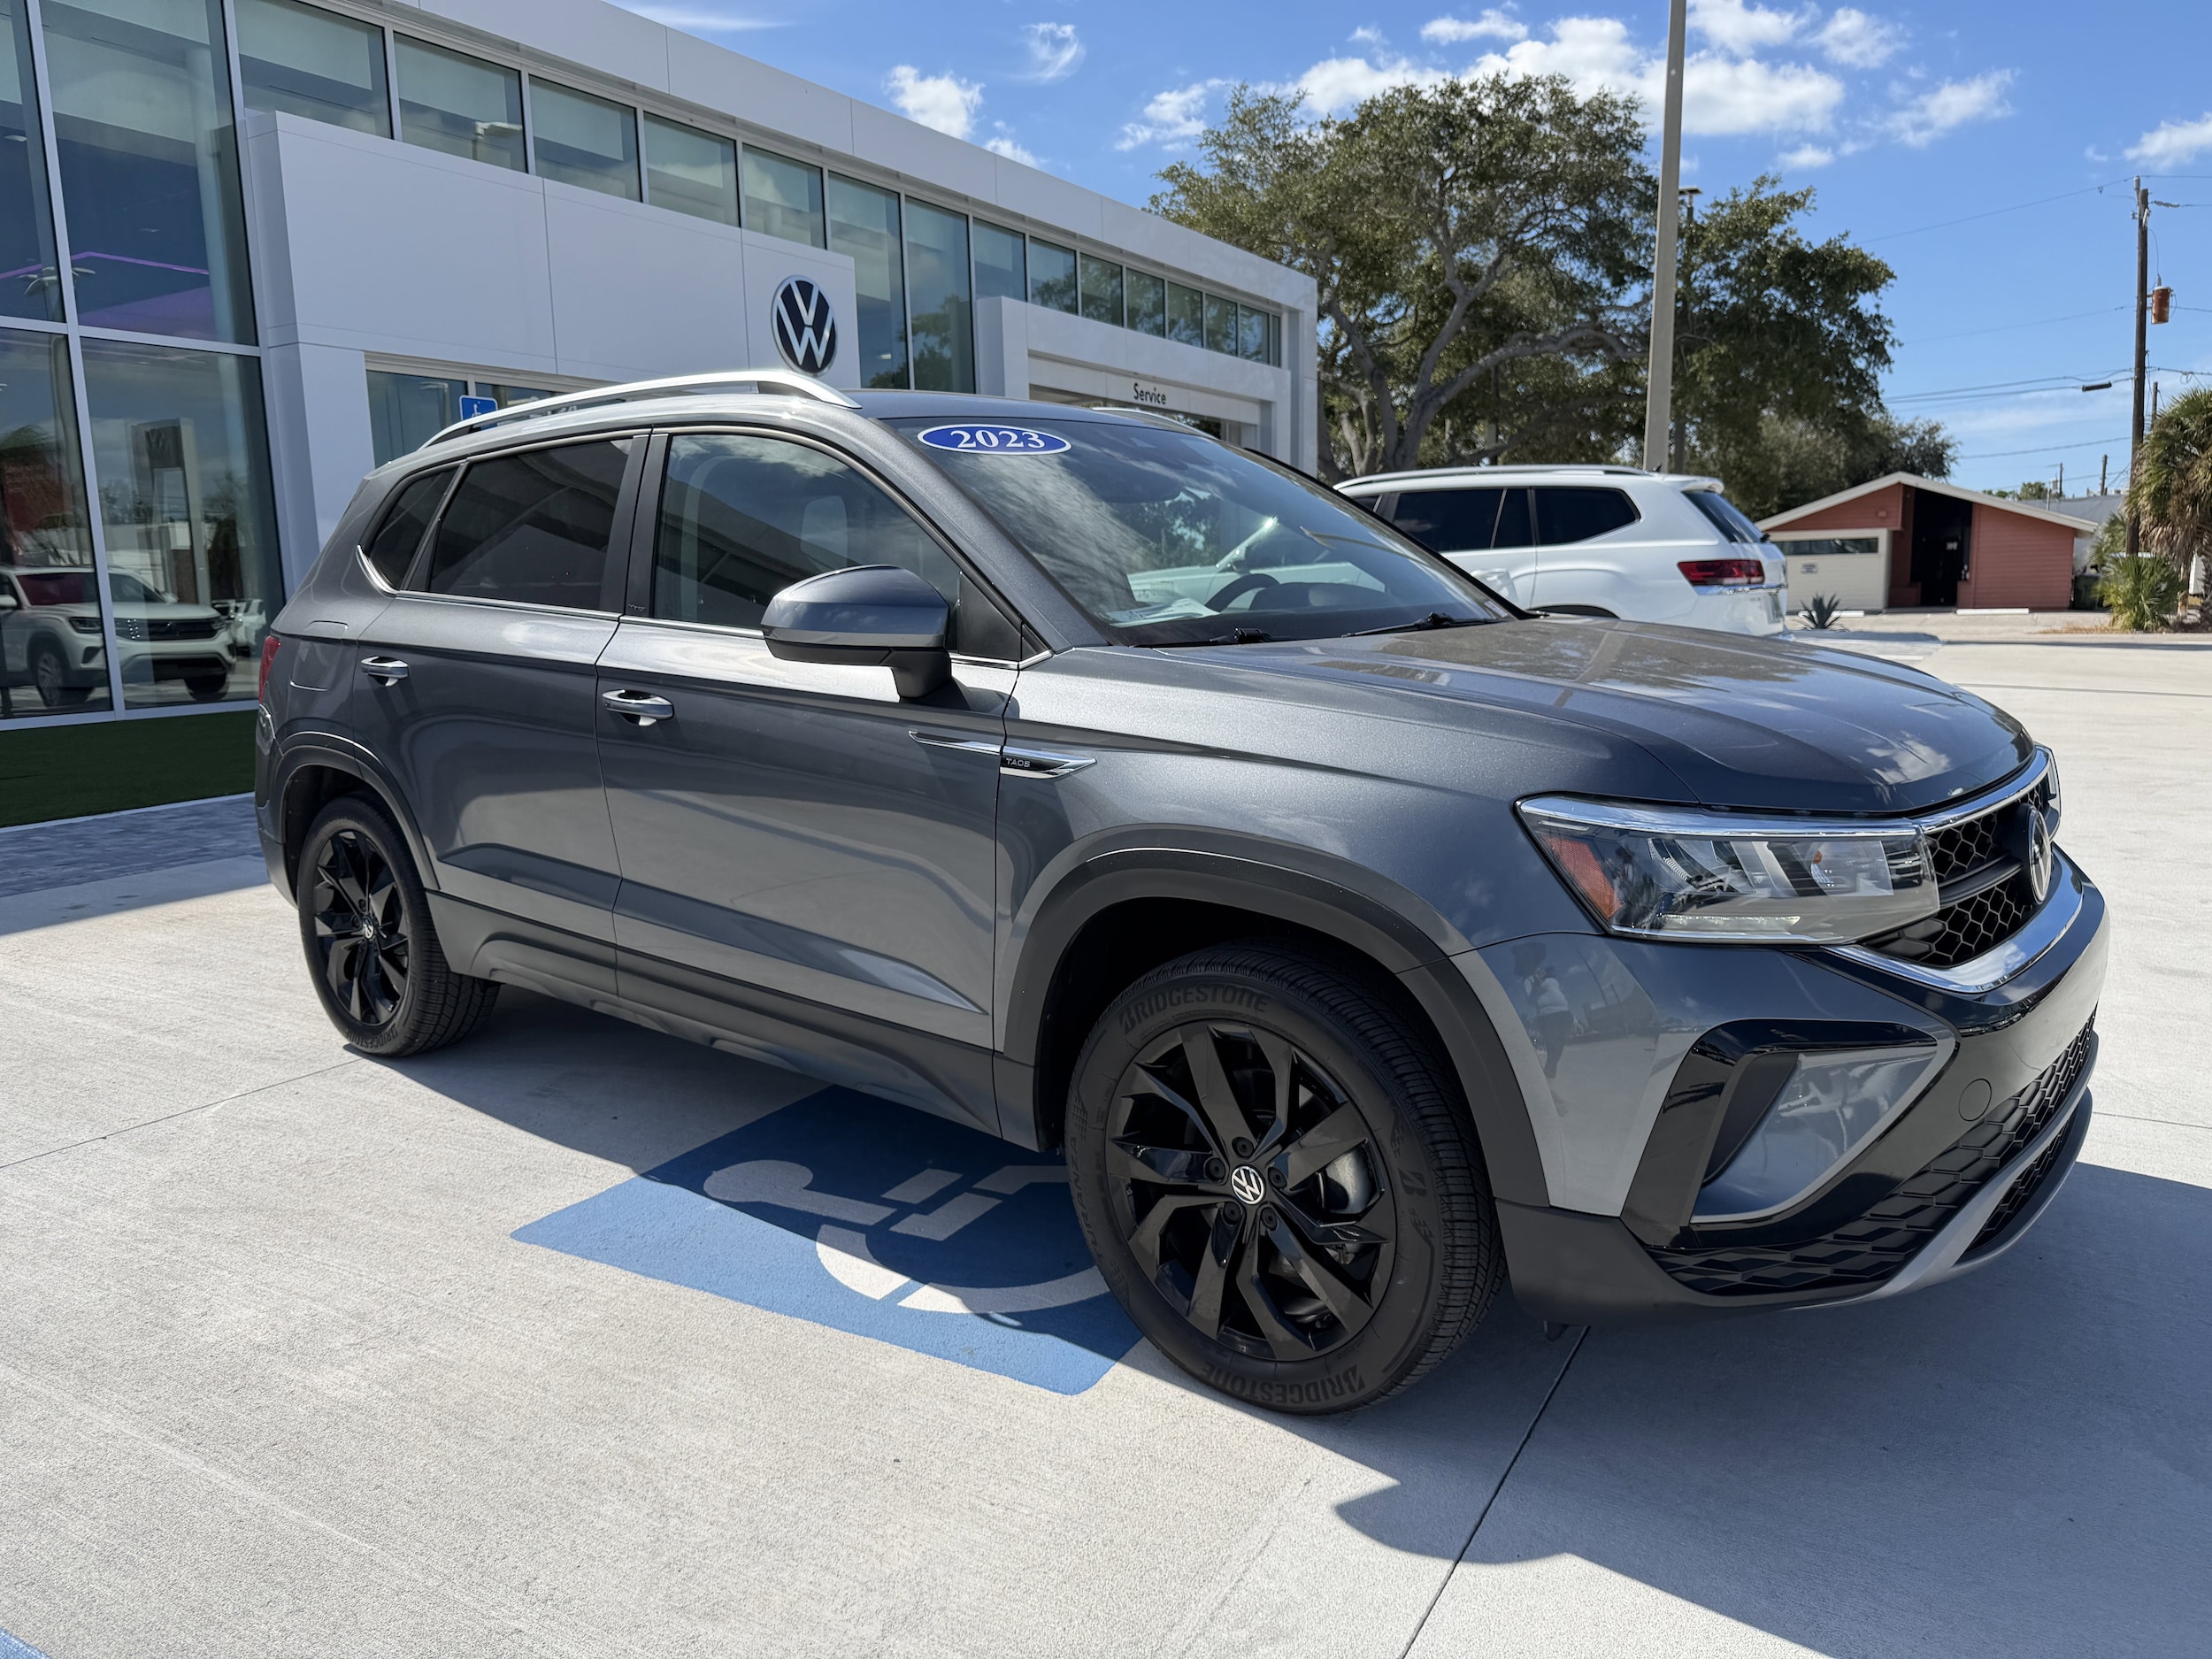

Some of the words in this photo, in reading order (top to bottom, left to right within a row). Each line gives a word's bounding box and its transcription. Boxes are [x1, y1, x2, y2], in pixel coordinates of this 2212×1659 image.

[1133, 382, 1166, 405] Service
[949, 429, 1046, 449] 2023
[1006, 757, 1031, 768] TAOS
[1119, 983, 1268, 1035] BRIDGESTONE
[1202, 1361, 1366, 1405] BRIDGESTONE
